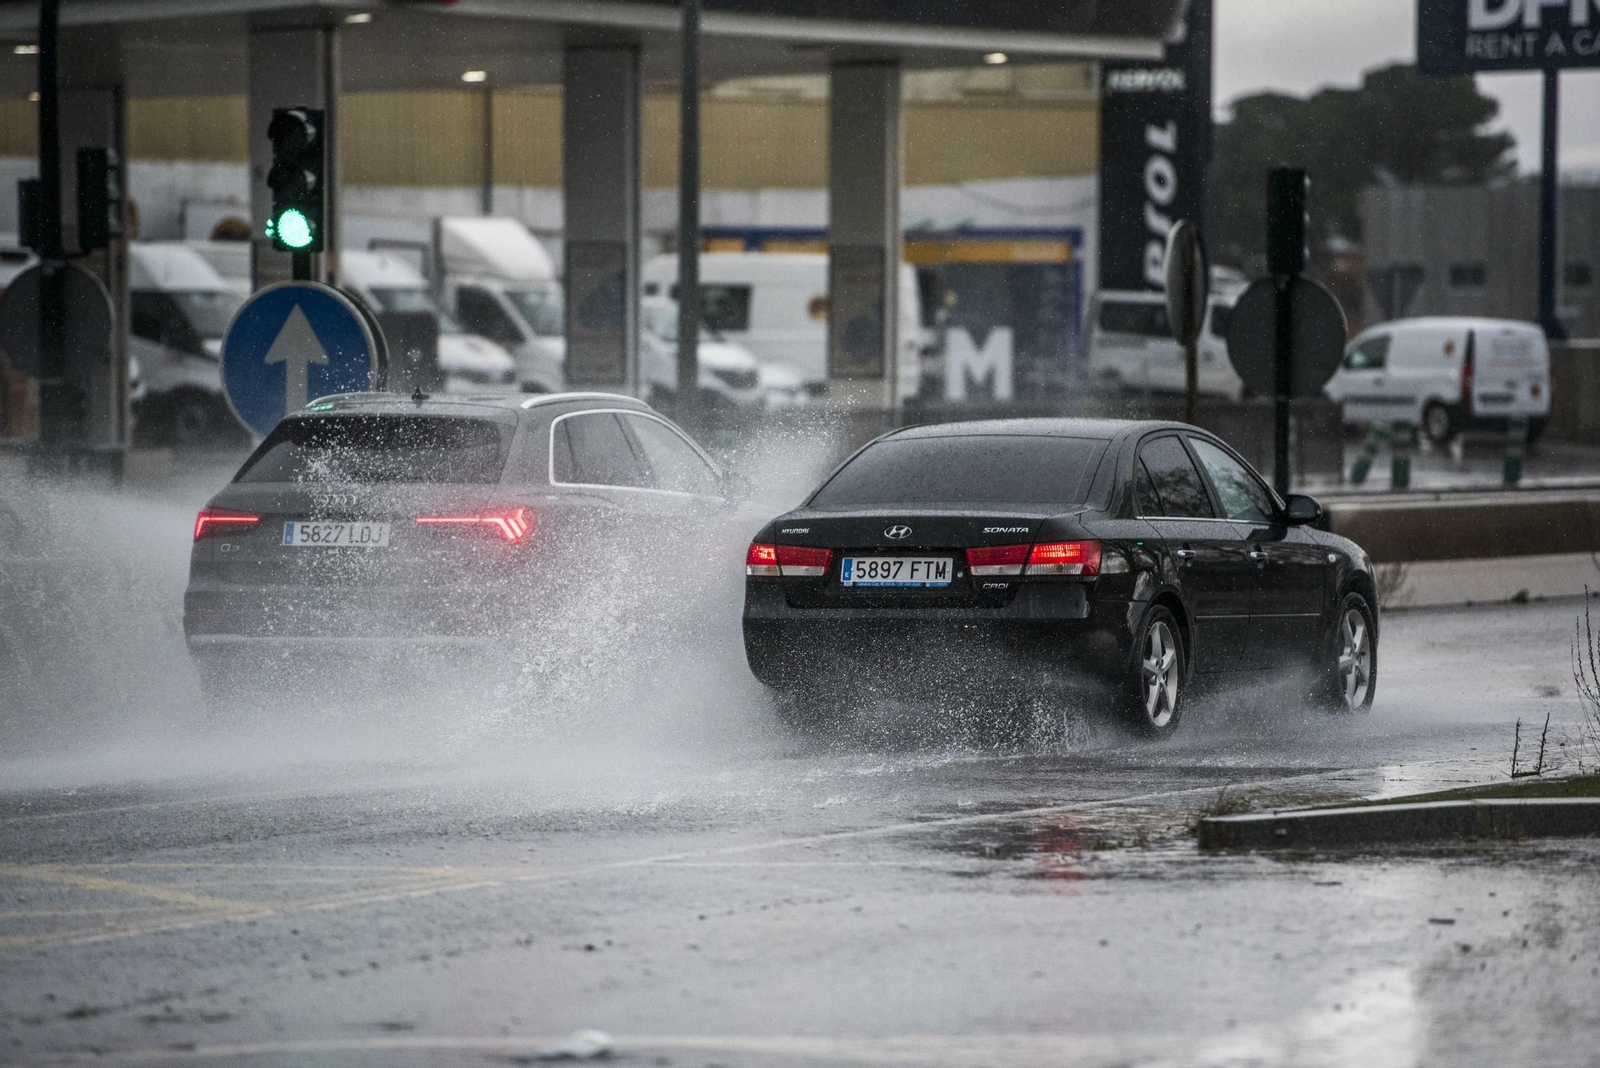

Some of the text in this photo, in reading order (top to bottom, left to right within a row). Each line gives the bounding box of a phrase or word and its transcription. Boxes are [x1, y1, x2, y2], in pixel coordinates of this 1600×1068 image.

[1465, 32, 1538, 59] RENT
[1545, 31, 1567, 56] A
[946, 327, 1013, 399] M
[300, 525, 383, 544] 5827 LDJ
[856, 561, 947, 580] 5897 FTM
